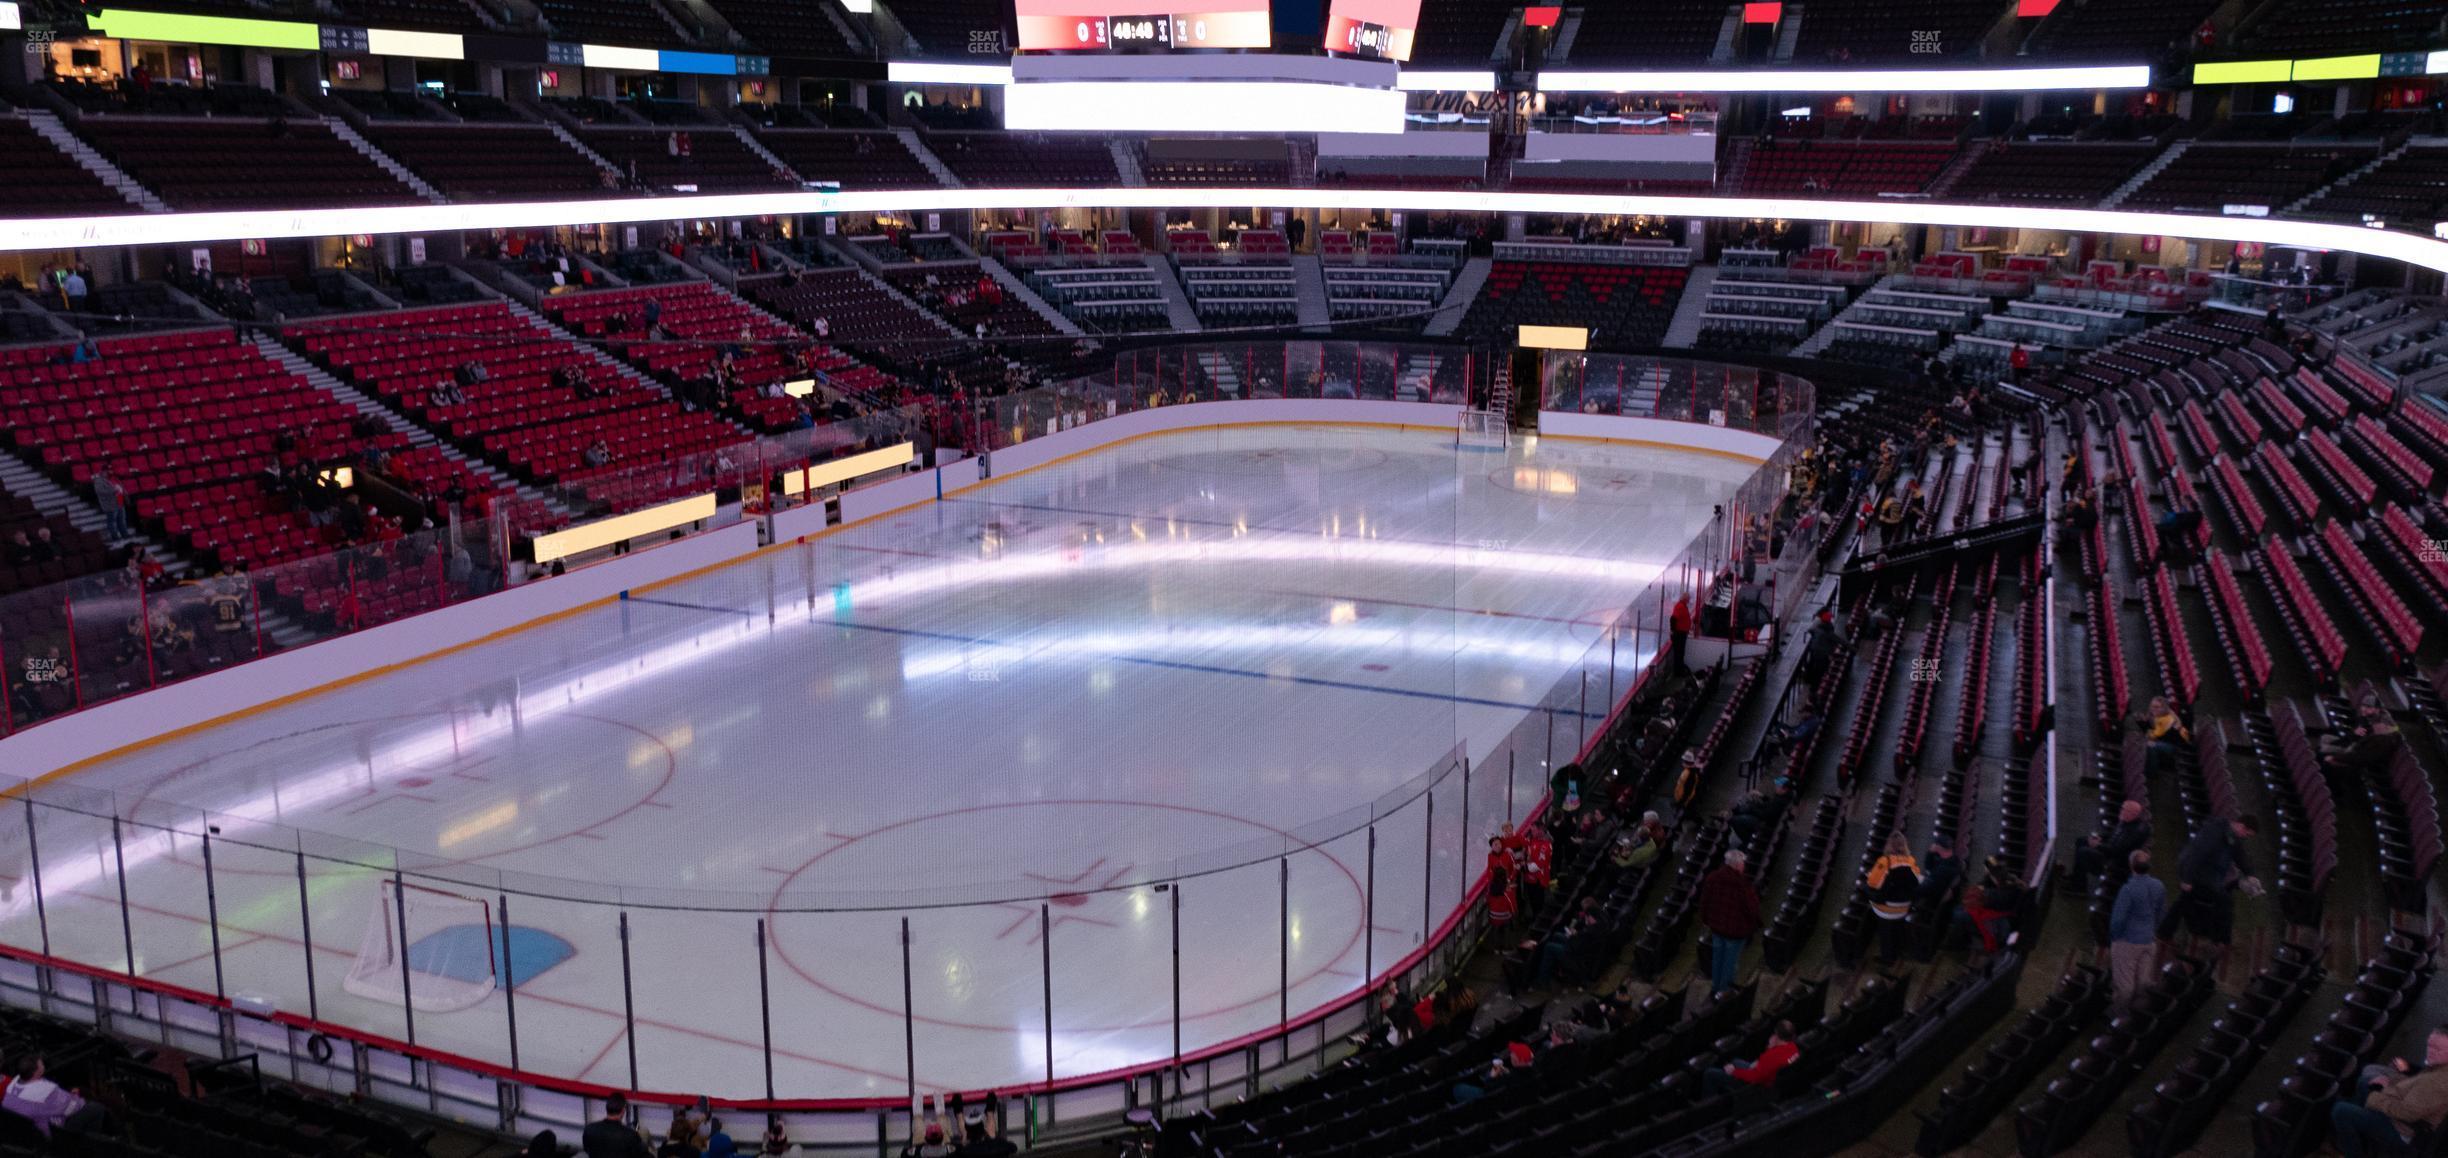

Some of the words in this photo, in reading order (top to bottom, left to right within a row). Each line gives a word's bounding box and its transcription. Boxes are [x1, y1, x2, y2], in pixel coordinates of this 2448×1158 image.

[1077, 22, 1089, 42] 0
[1195, 20, 1207, 41] 0
[1426, 89, 1537, 115] Molsn
